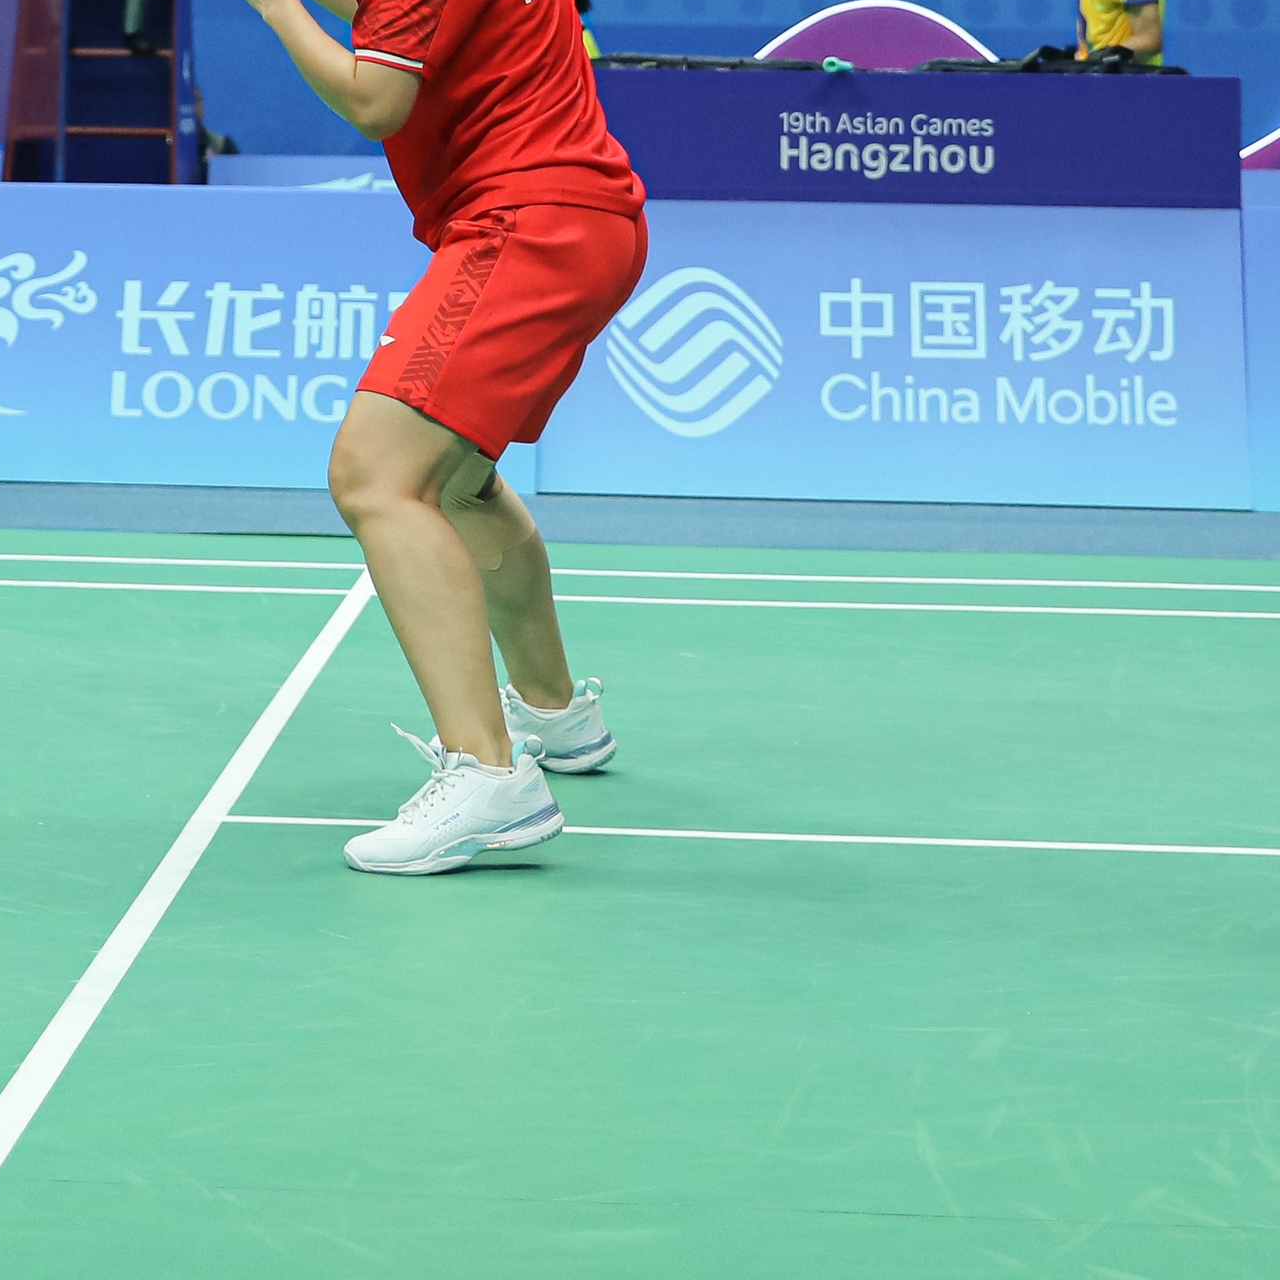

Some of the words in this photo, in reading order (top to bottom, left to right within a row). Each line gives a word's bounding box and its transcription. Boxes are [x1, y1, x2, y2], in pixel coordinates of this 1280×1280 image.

[779, 111, 831, 134] 19th
[835, 112, 905, 135] Asian
[910, 113, 994, 136] Games
[779, 135, 995, 179] Hangzhou
[116, 279, 410, 360] 长龙航
[819, 277, 1176, 364] 中国移动
[110, 370, 348, 424] LOONG
[821, 372, 980, 423] China
[996, 376, 1178, 427] Mobile
